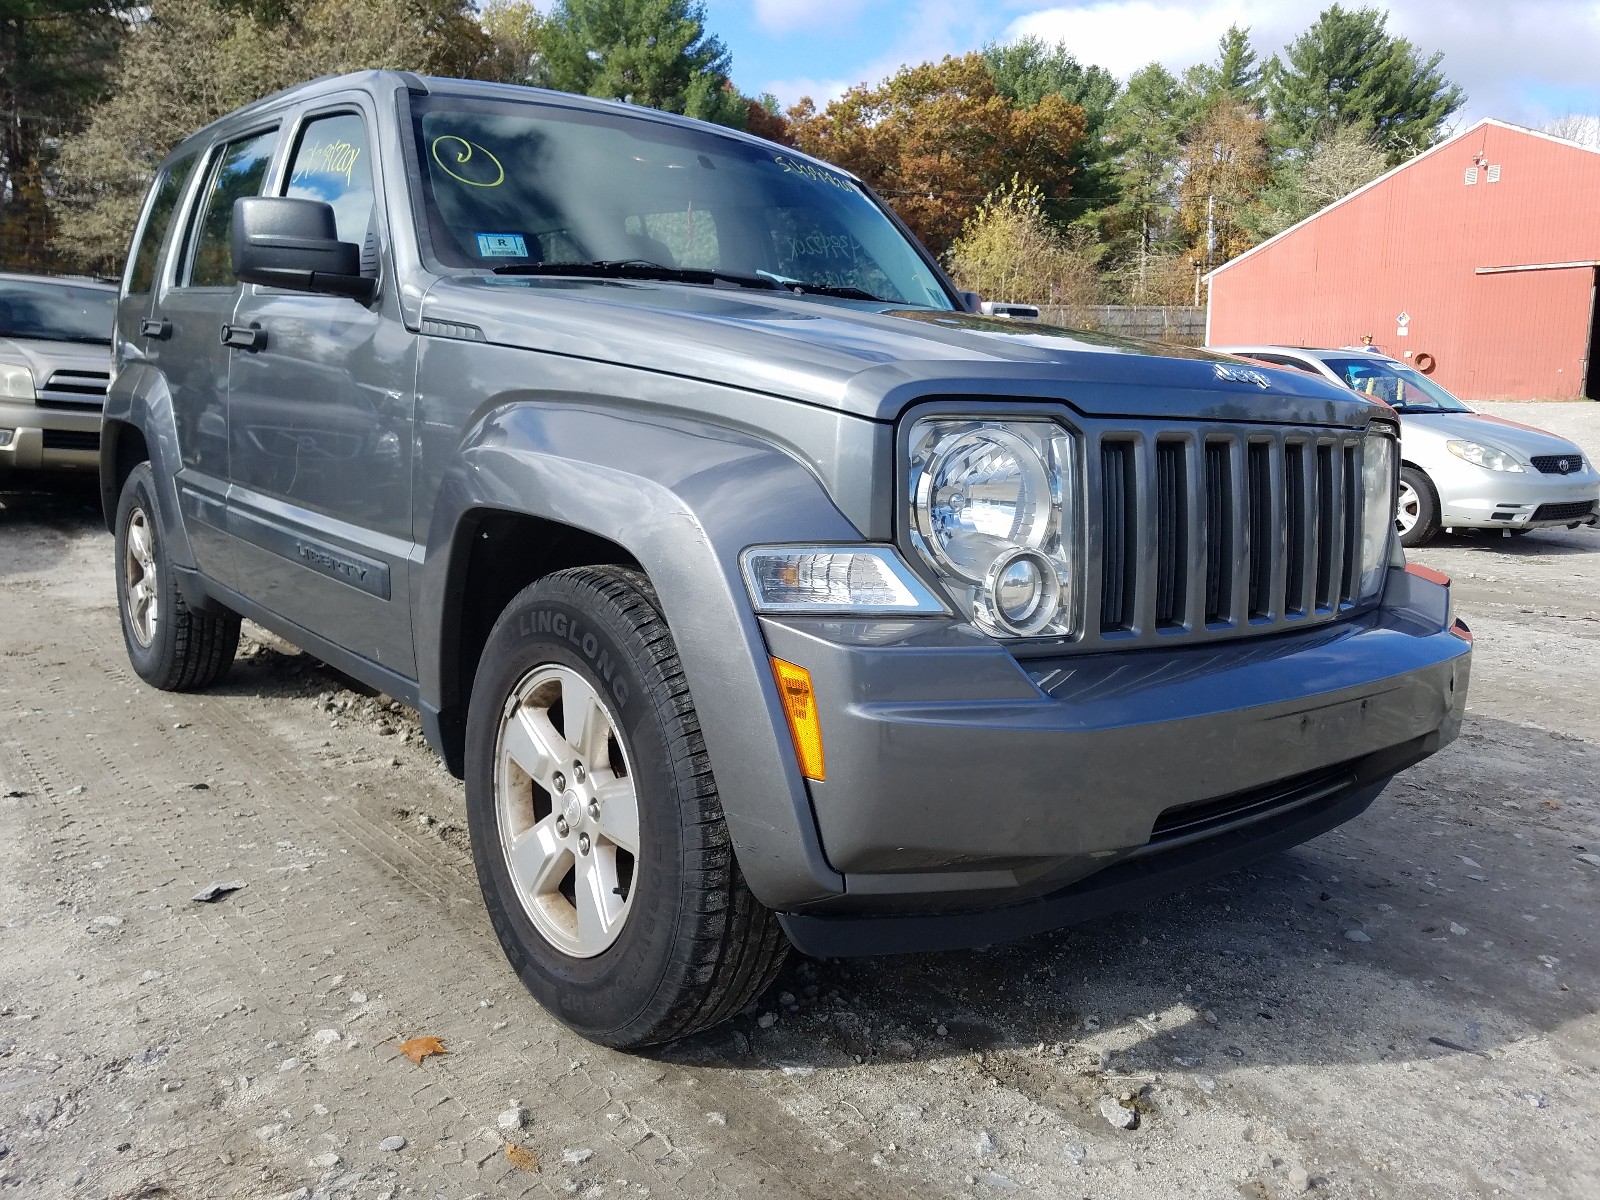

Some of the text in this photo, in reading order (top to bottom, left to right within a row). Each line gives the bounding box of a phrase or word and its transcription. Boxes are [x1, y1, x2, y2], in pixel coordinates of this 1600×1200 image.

[497, 238, 508, 247] R
[1213, 363, 1271, 389] Jeep
[295, 541, 368, 581] LIBERTY
[519, 610, 629, 708] LINGLONG
